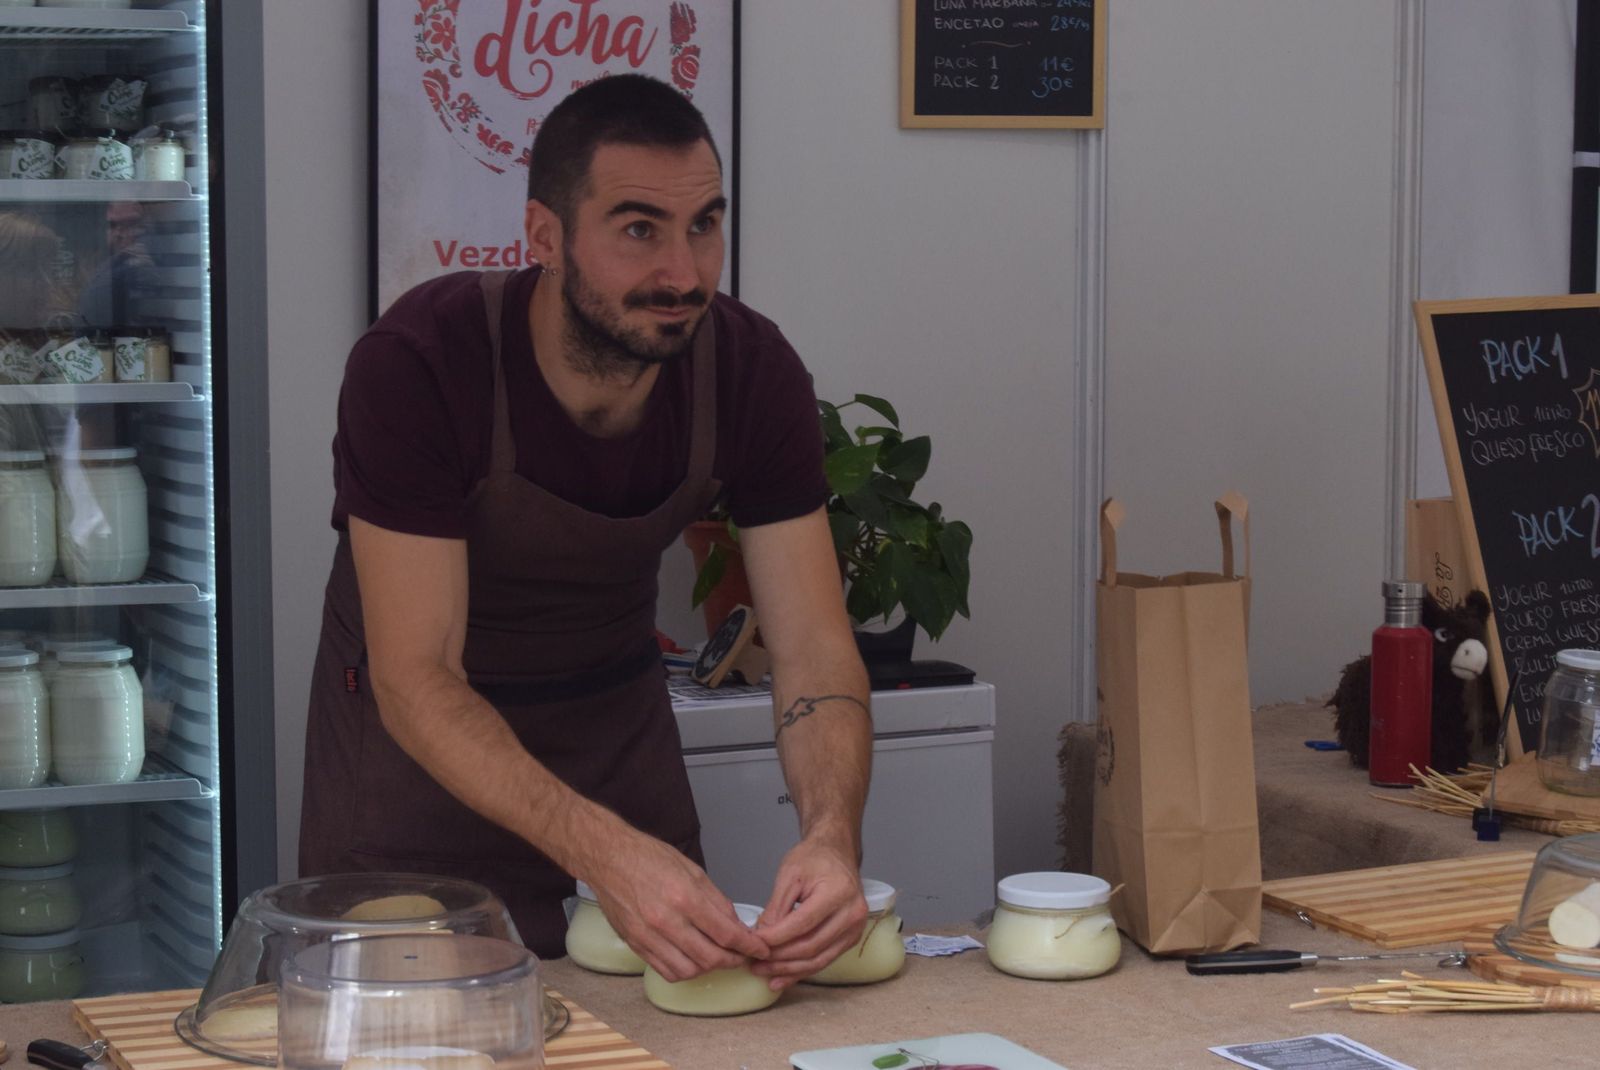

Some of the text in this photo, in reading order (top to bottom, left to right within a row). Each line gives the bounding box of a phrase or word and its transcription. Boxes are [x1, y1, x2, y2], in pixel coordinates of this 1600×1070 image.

[934, 17, 1004, 30] ENCETAO
[474, 0, 658, 100] dicha
[933, 55, 1074, 72] PACK 1 11€
[933, 73, 980, 89] PACK
[990, 75, 1000, 90] 2
[1480, 332, 1568, 384] PACK 1
[1462, 402, 1524, 437] YOGUR
[1471, 430, 1586, 466] QUESO FRESCO
[1511, 506, 1584, 558] PACK
[1497, 581, 1552, 612] YOGUR
[1504, 605, 1553, 632] QUESO
